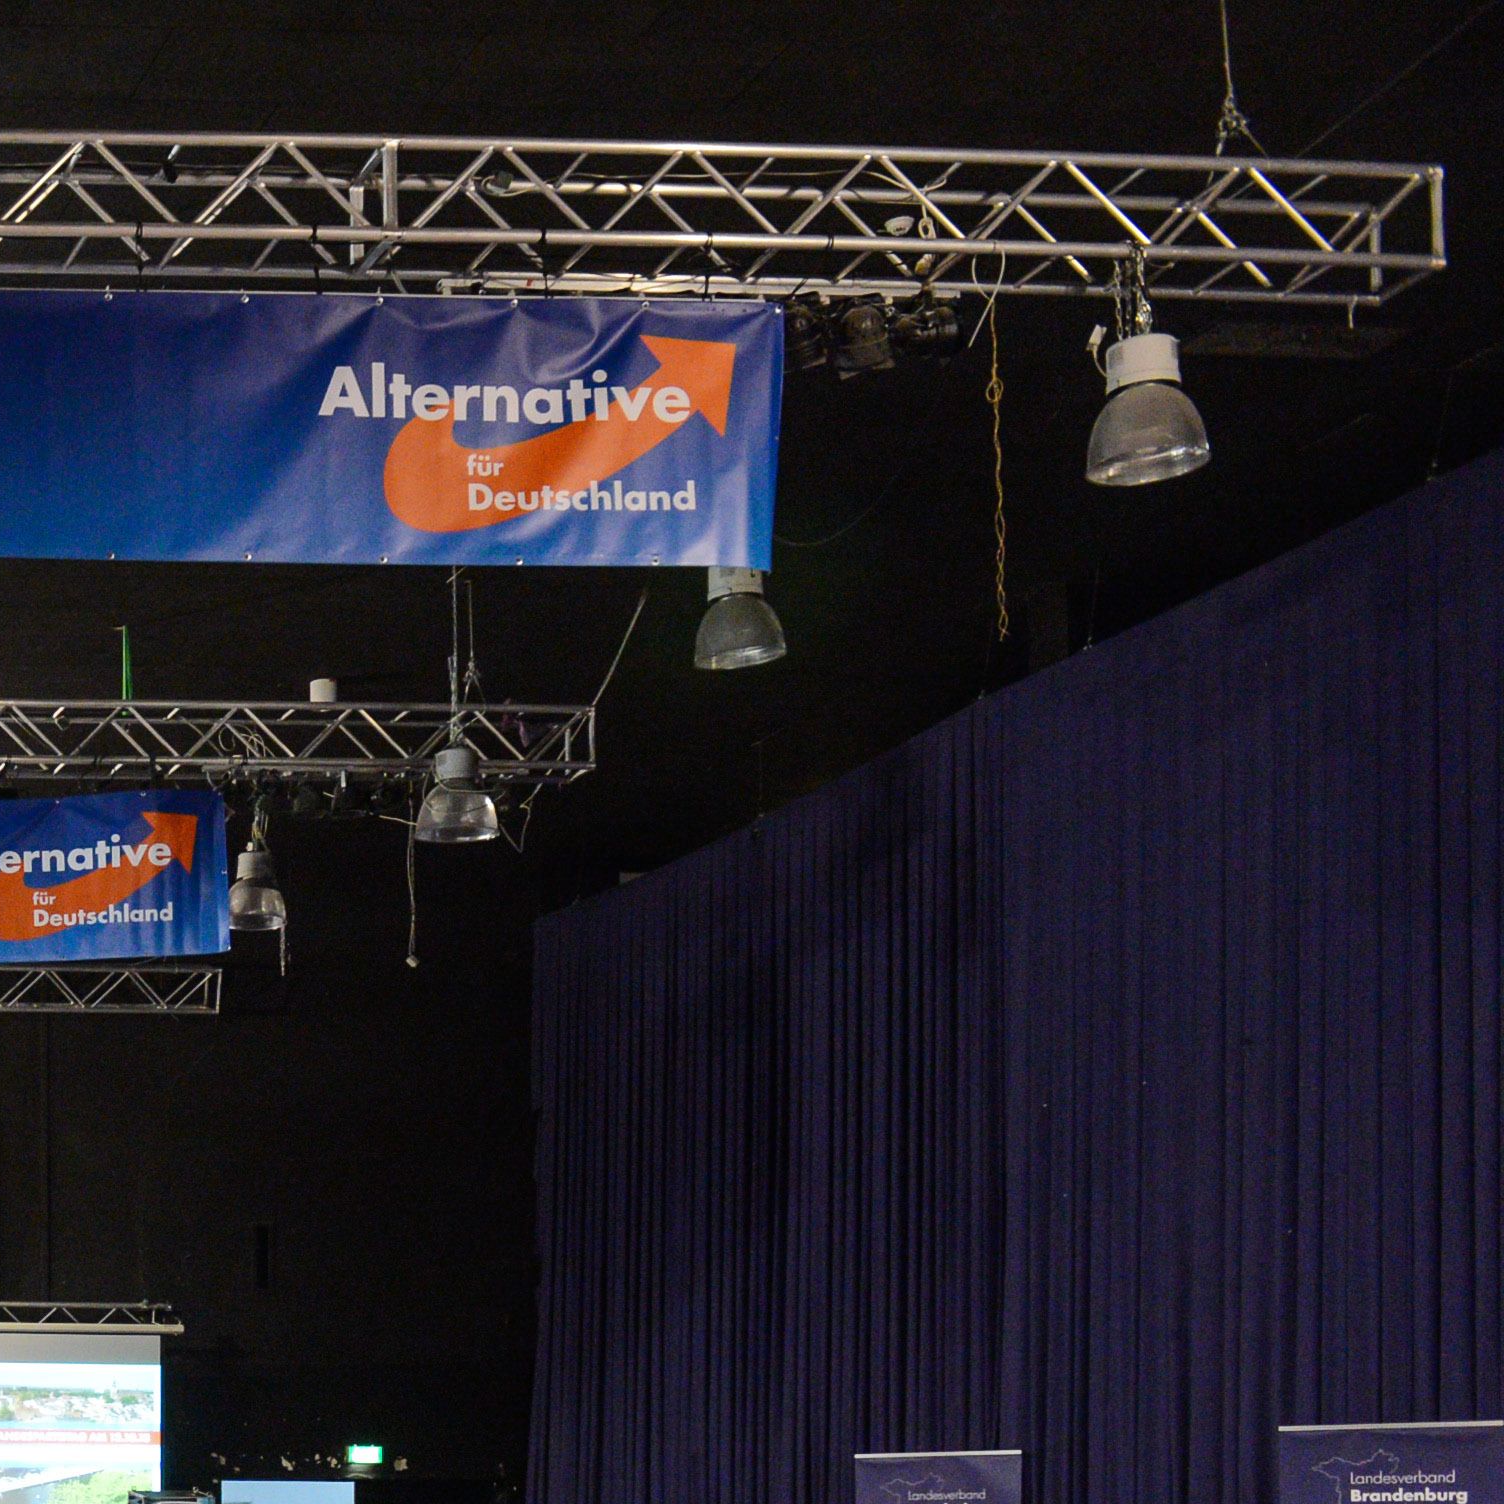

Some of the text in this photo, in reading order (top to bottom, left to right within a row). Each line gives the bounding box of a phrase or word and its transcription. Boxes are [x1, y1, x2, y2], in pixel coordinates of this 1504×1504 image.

[318, 361, 692, 425] Alternative
[466, 454, 504, 477] für
[467, 480, 697, 512] Deutschland
[32, 892, 56, 906] für
[32, 902, 173, 928] Deutschland
[1350, 1470, 1456, 1485] Landesverband
[908, 1489, 986, 1501] Landesverband
[1350, 1487, 1468, 1504] Brandenburg
